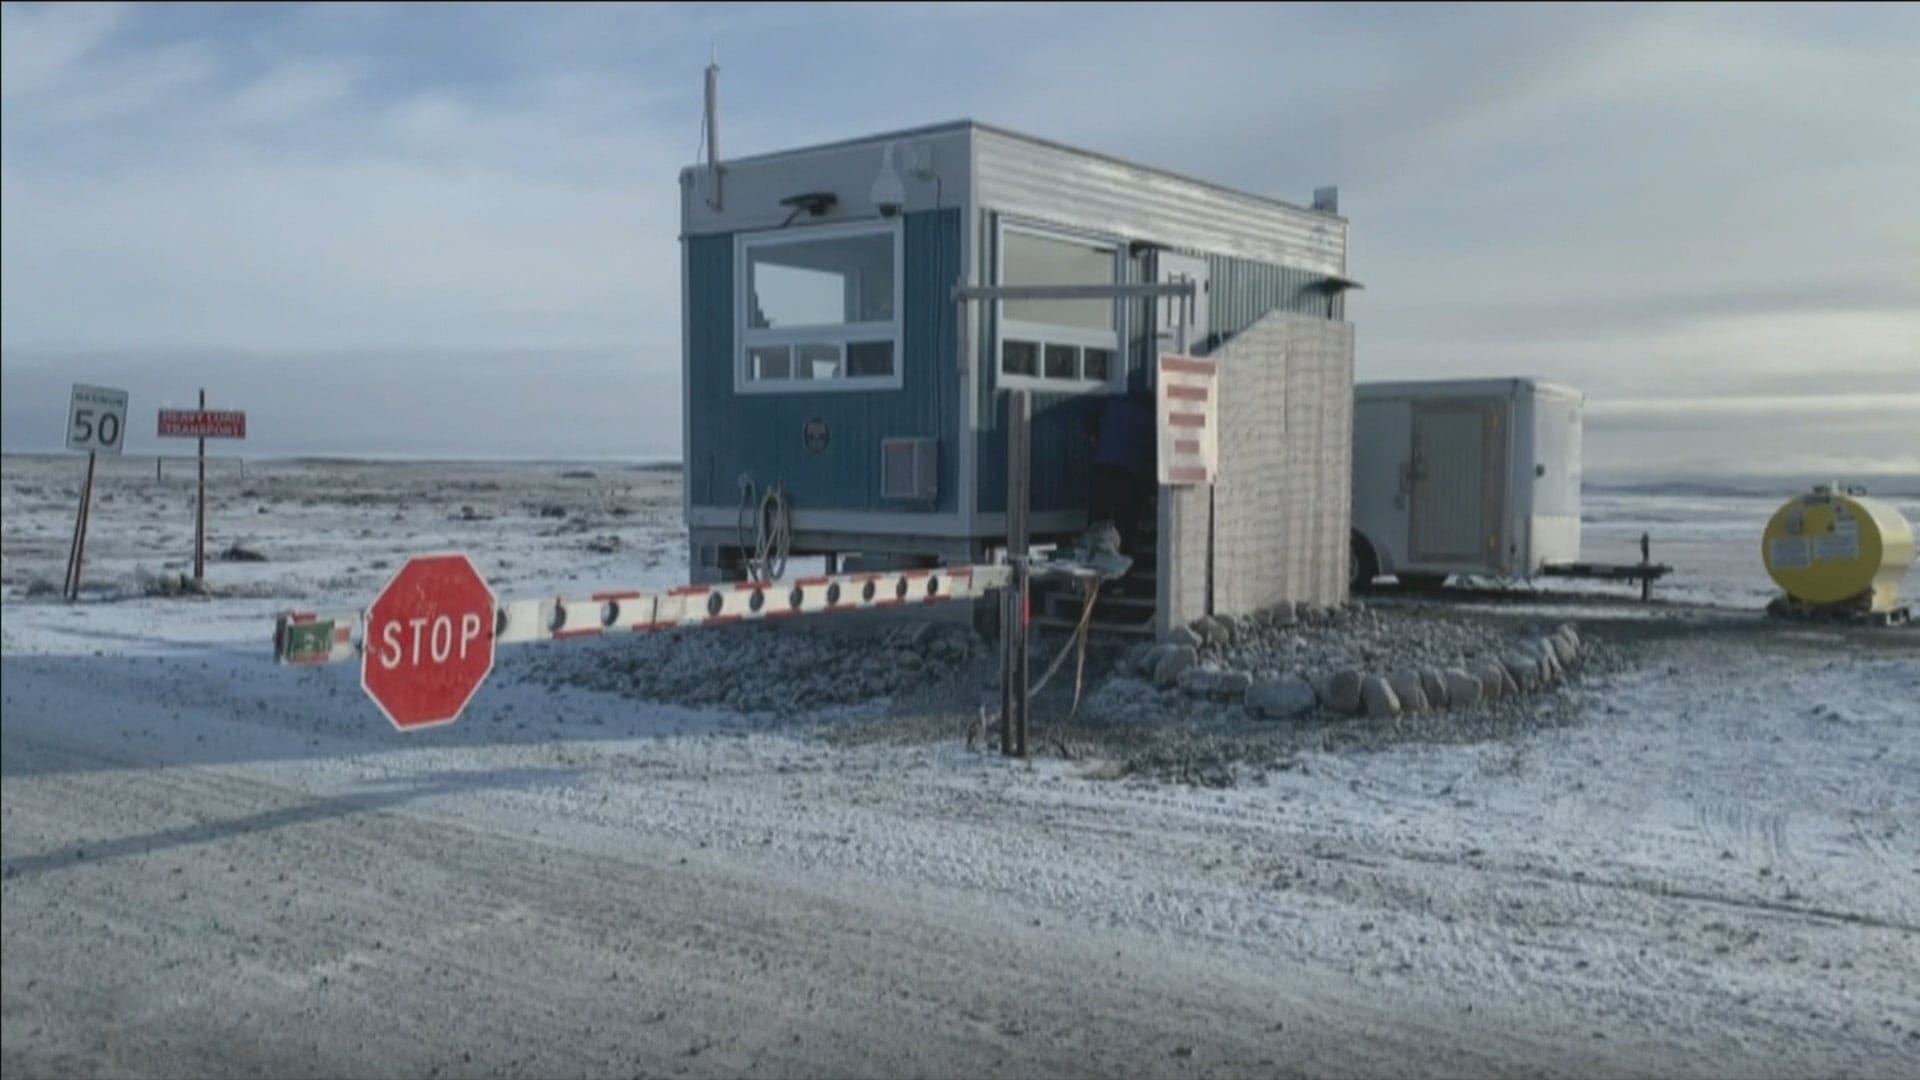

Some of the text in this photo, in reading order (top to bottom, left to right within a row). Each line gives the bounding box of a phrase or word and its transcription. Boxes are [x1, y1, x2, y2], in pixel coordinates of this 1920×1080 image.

[75, 392, 123, 407] MAXIMUM
[73, 409, 119, 447] 50
[380, 612, 480, 669] STOP
